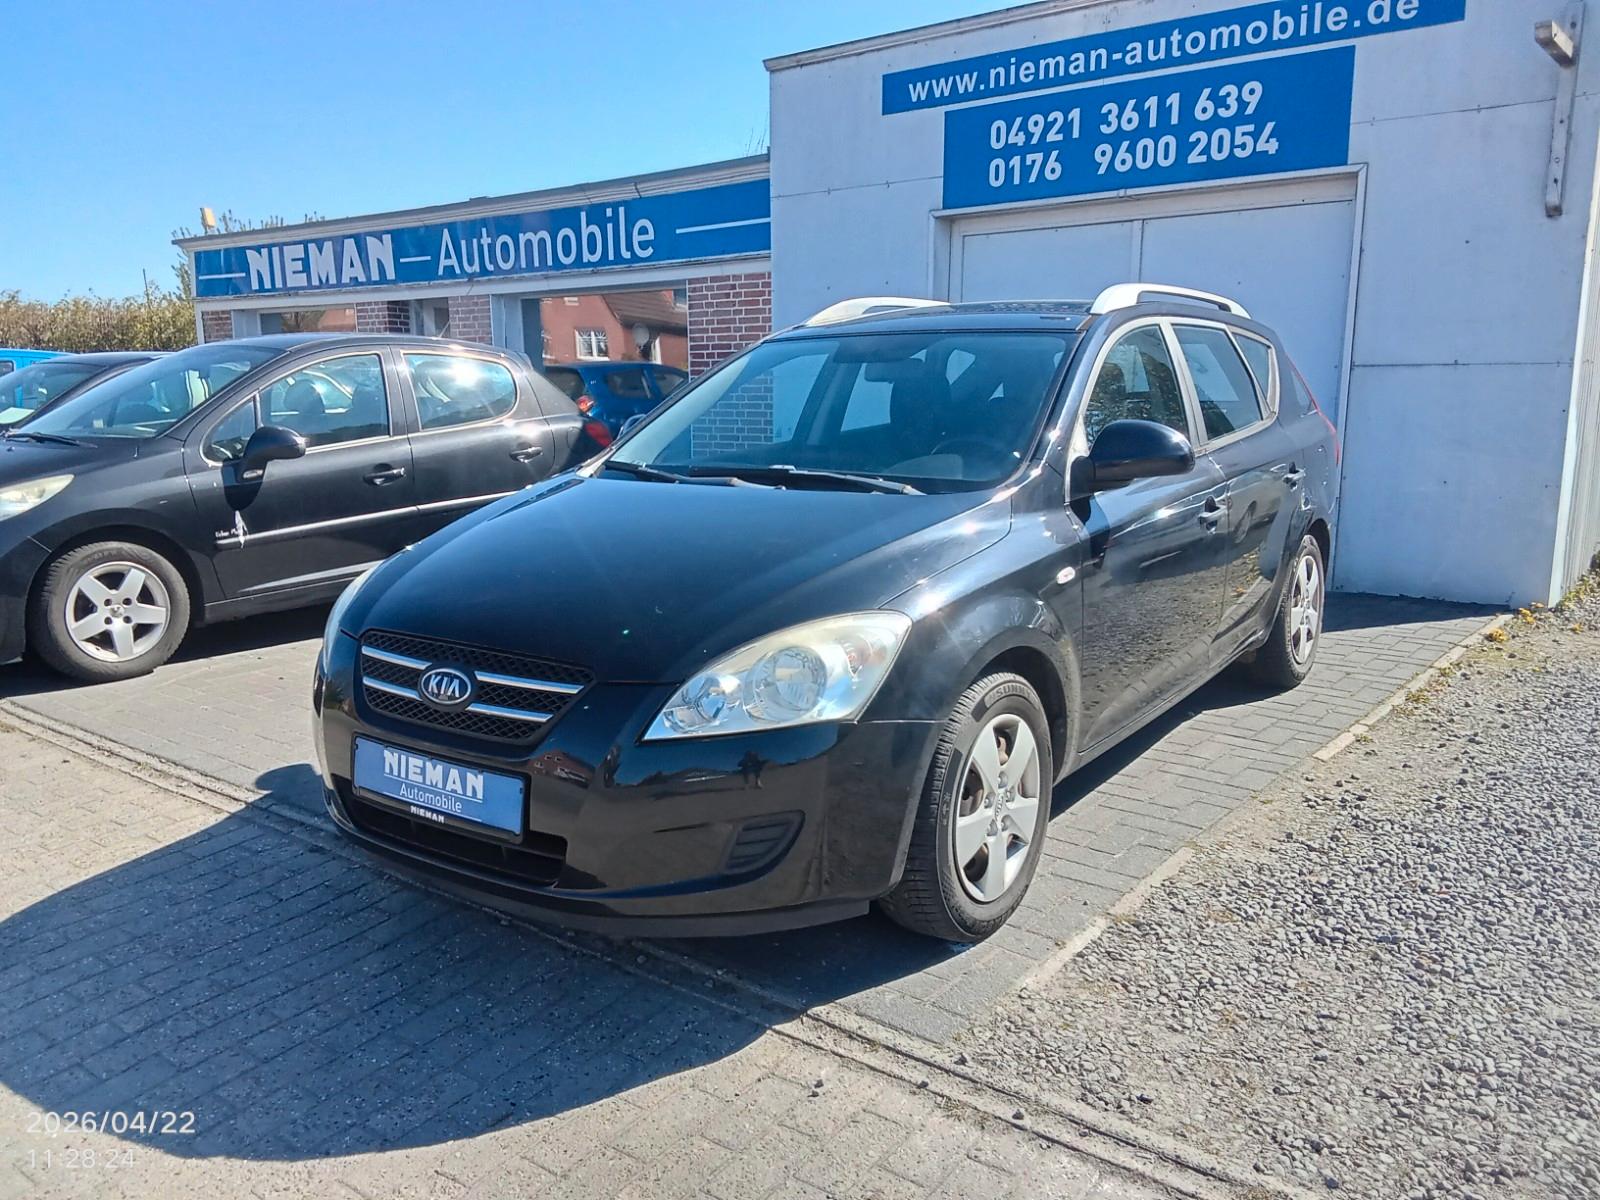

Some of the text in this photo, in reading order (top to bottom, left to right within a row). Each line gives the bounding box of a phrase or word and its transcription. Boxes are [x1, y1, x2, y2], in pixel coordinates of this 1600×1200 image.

[908, 0, 1420, 103] www.nieman-automobile.de
[990, 80, 1264, 150] 04921 3611 639
[988, 121, 1279, 188] 0176 9600 2054
[245, 206, 655, 291] NIEMAN Automobile
[427, 673, 461, 698] KIA
[383, 749, 484, 800] NIEMAN
[399, 783, 463, 813] Automobile
[410, 805, 445, 824] NIEMAN
